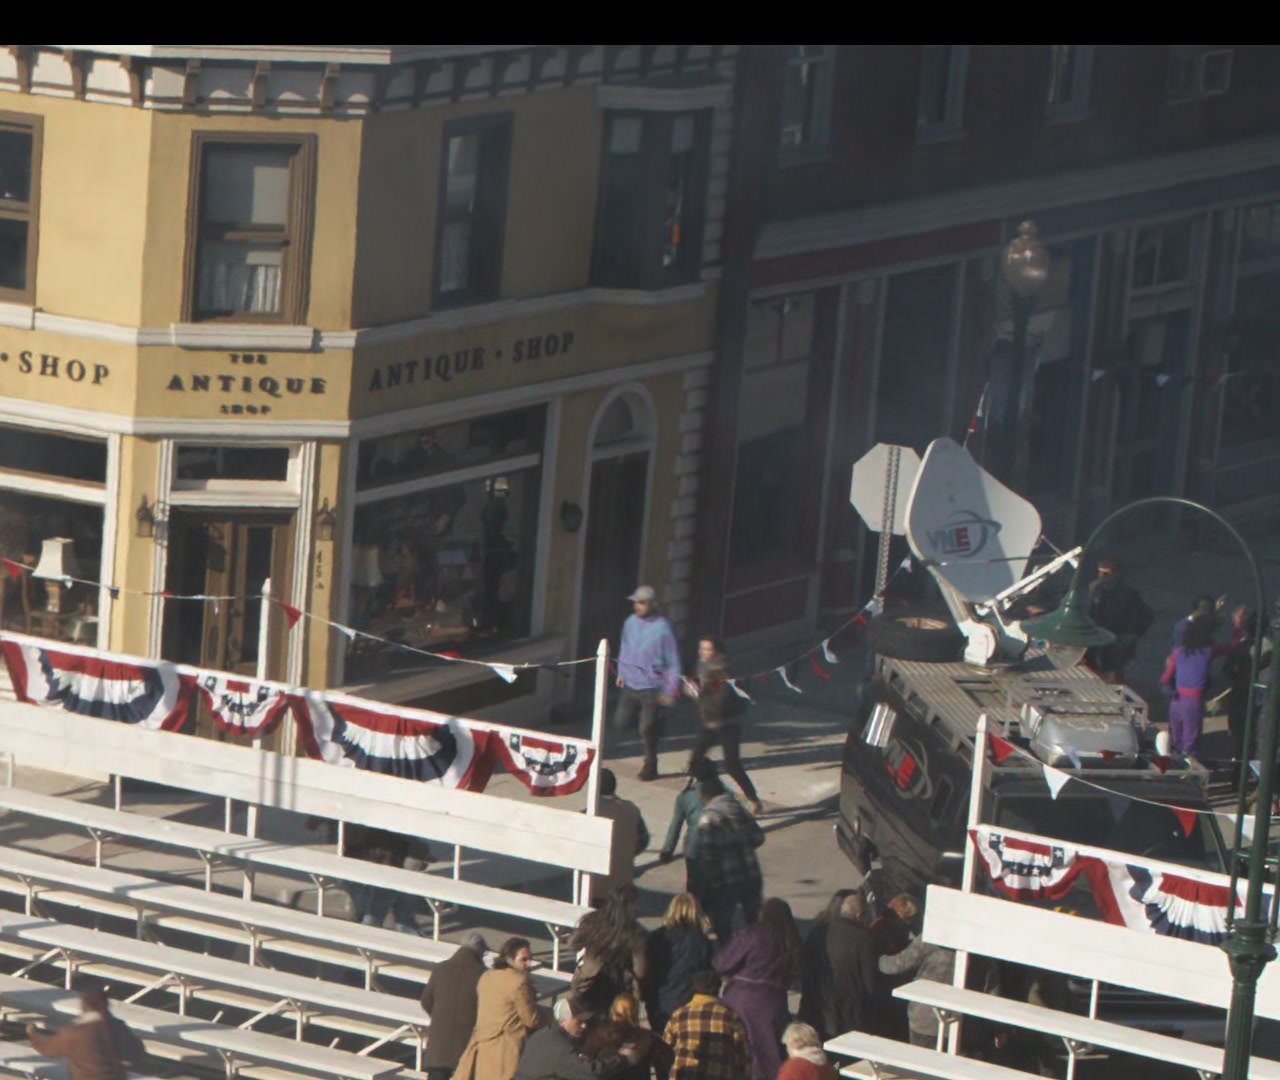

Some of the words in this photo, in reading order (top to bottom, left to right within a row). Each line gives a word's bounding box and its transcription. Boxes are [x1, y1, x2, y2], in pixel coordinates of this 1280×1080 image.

[18, 350, 110, 385] SHOP
[368, 346, 485, 392] ANTIQUE
[512, 331, 574, 363] SHOP
[166, 374, 328, 399] ANTIQUE
